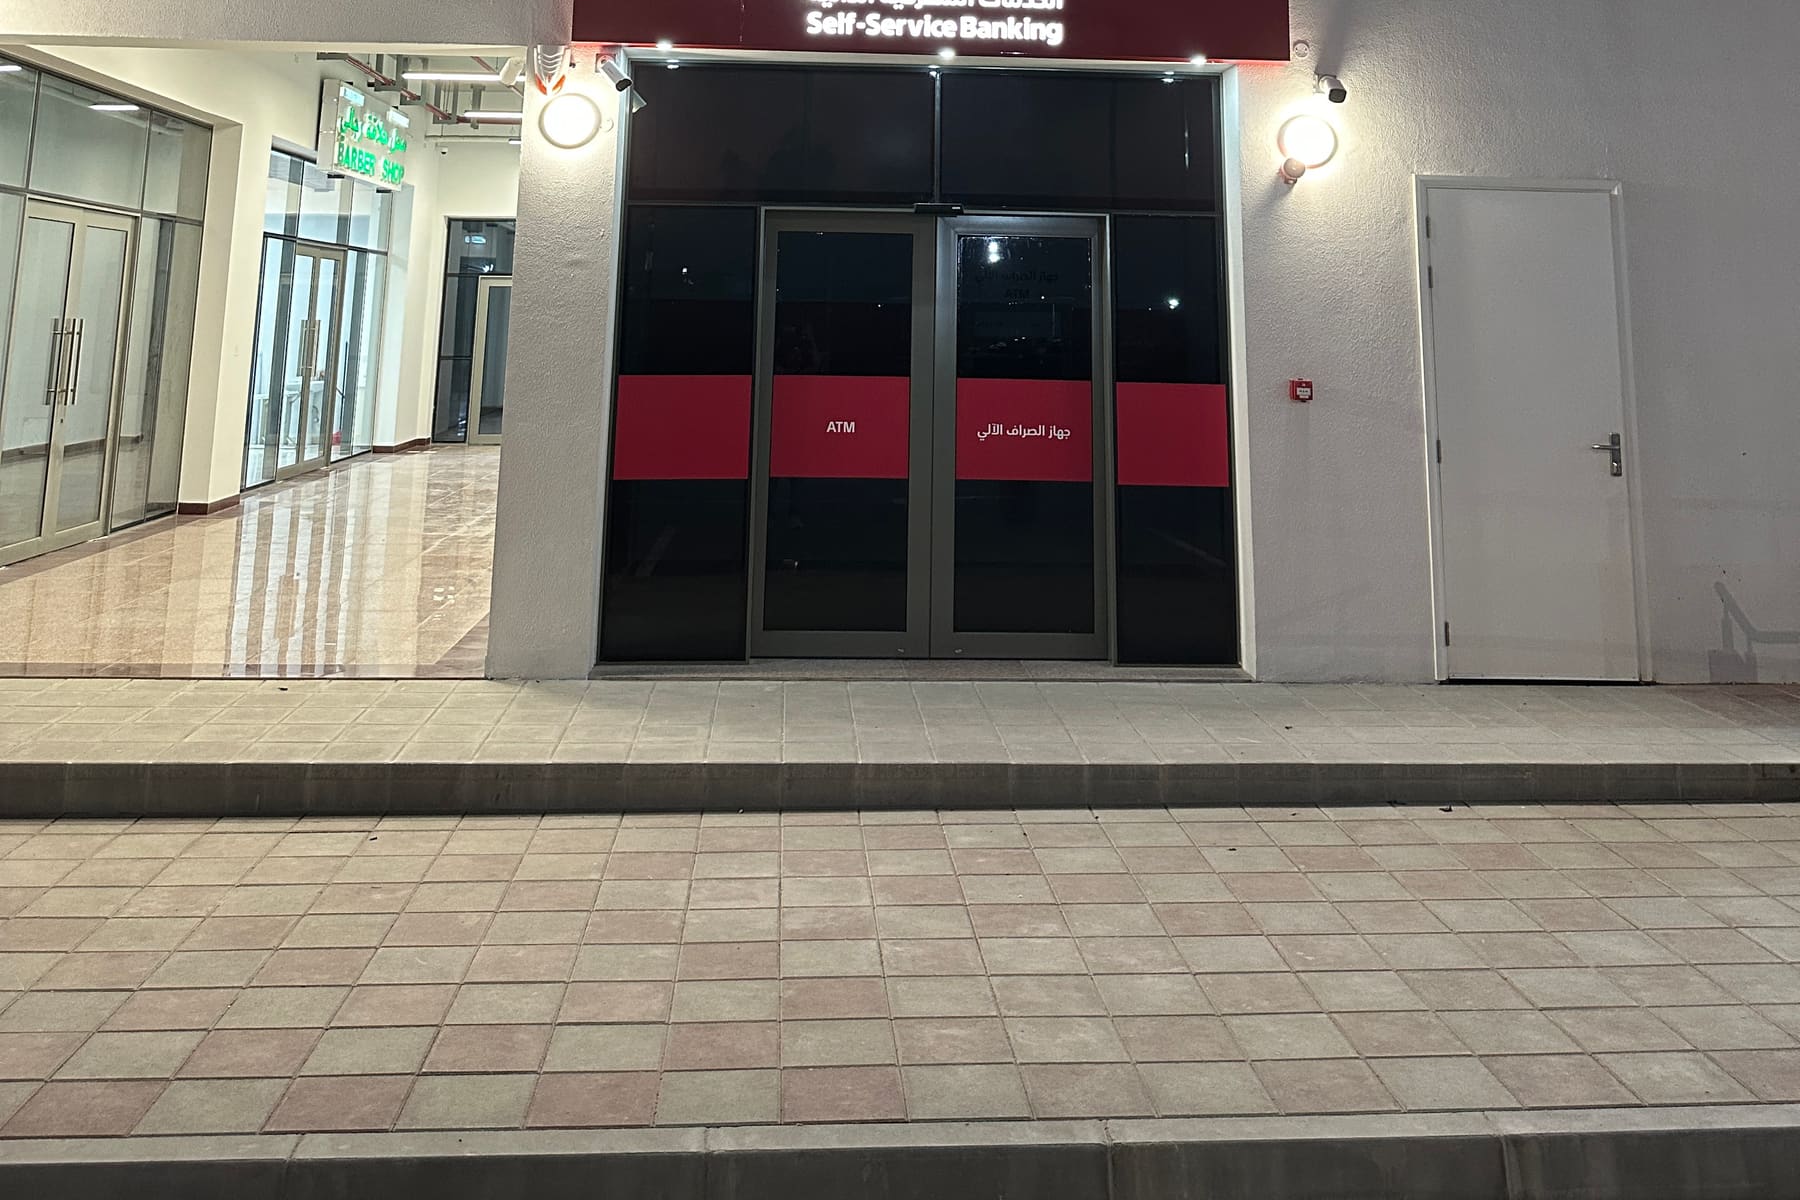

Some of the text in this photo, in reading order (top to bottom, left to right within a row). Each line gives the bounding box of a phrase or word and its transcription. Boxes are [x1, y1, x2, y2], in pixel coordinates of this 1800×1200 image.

[806, 11, 1063, 46] Self-Service Banking
[338, 142, 404, 184] BARBER SHOP
[826, 421, 855, 433] ATM
[977, 423, 1071, 441] جهاز الصراف الآلي
